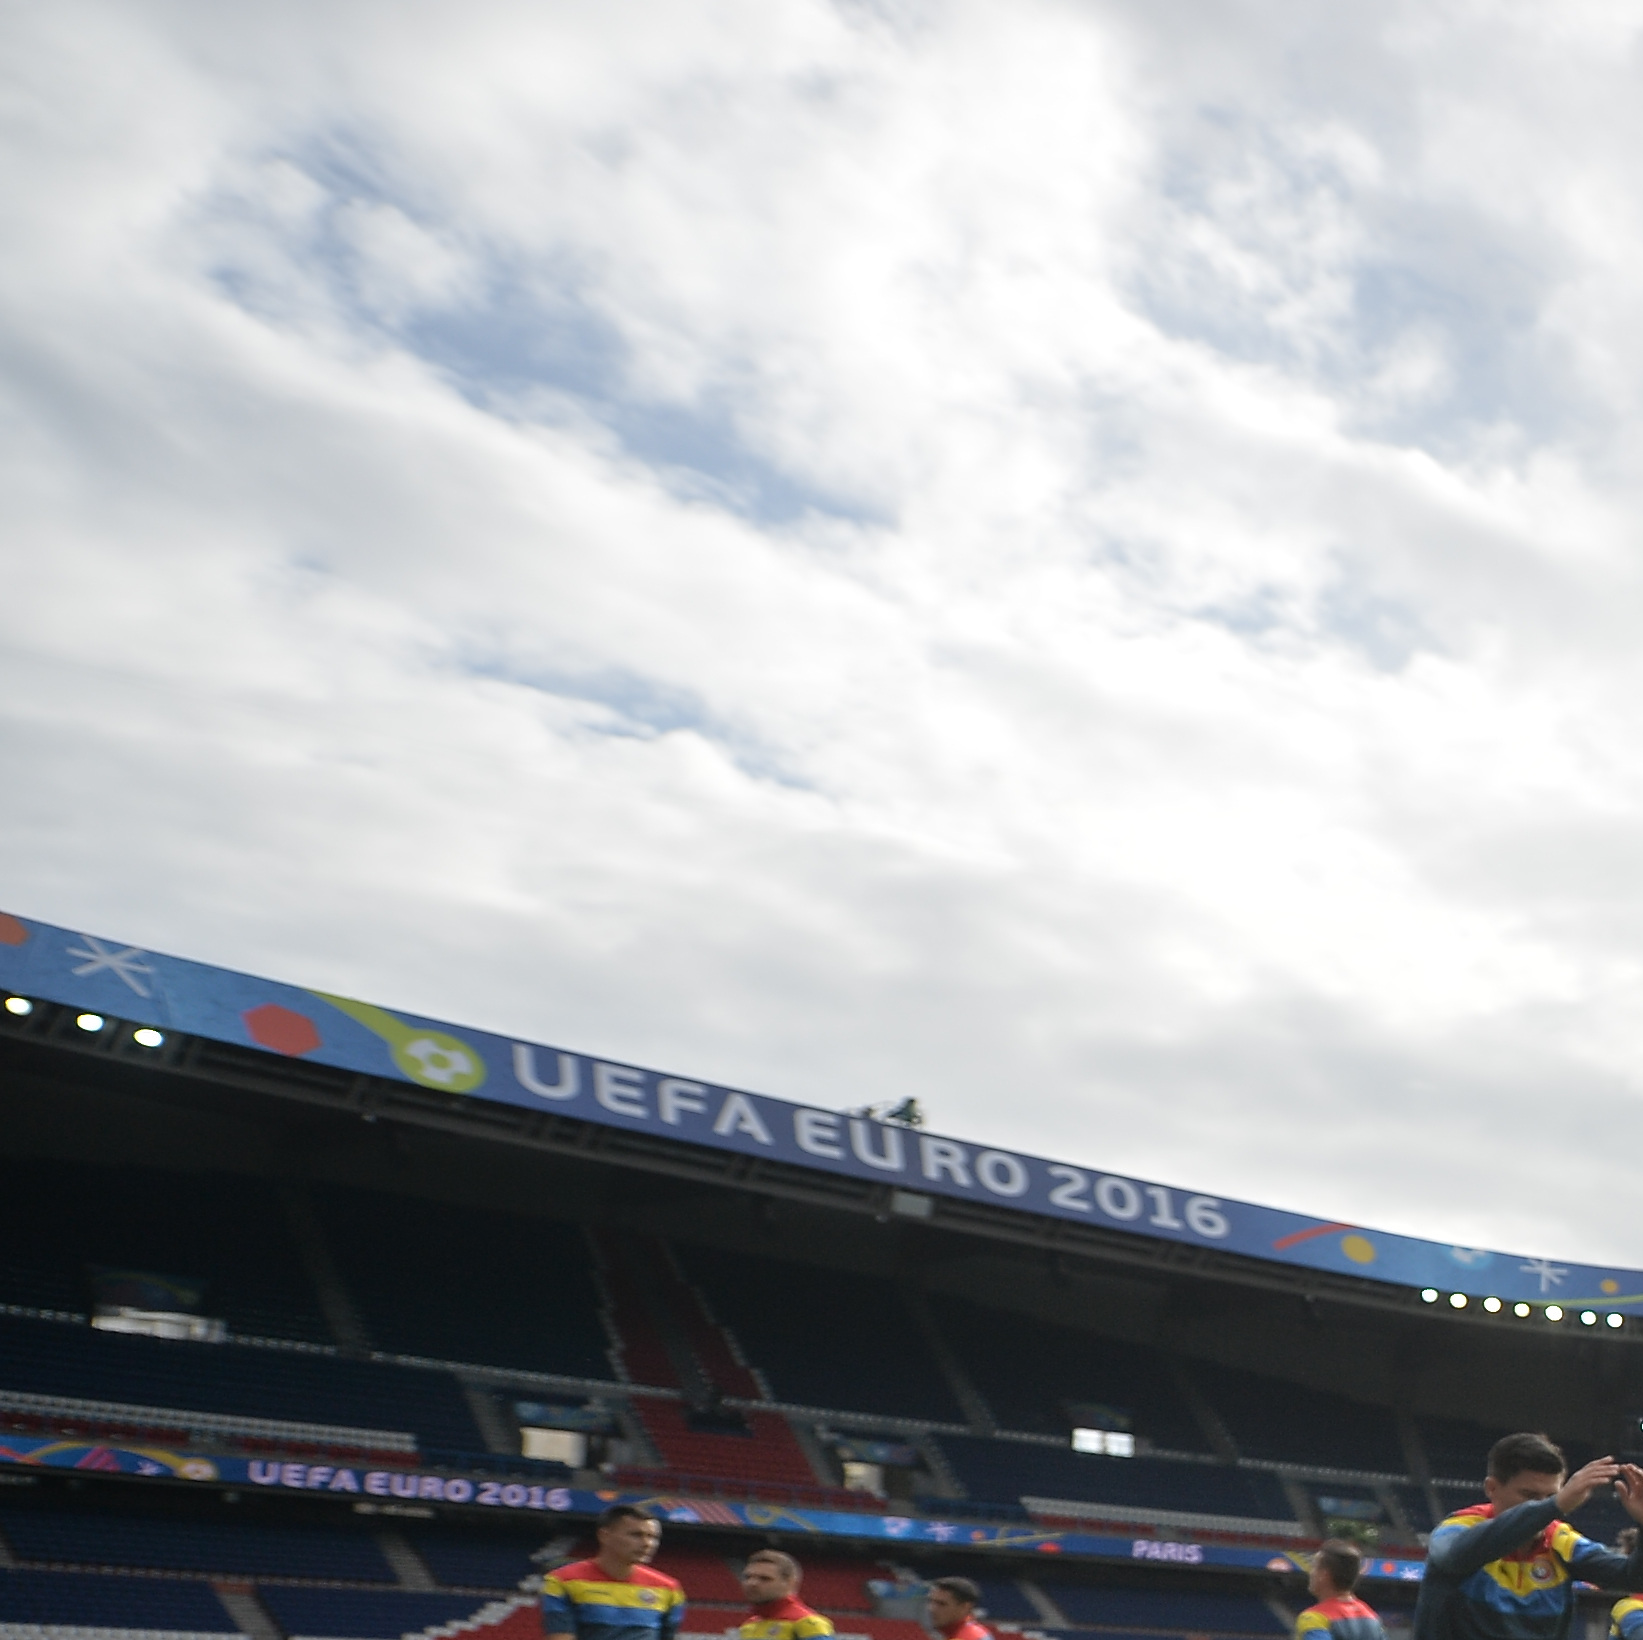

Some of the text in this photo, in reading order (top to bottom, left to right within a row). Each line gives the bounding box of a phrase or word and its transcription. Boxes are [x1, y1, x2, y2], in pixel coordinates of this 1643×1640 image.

[511, 1043, 1231, 1239] UEFA EURO 2016
[247, 1459, 573, 1511] UEFA EURO 2016
[1132, 1539, 1203, 1564] PARIS
